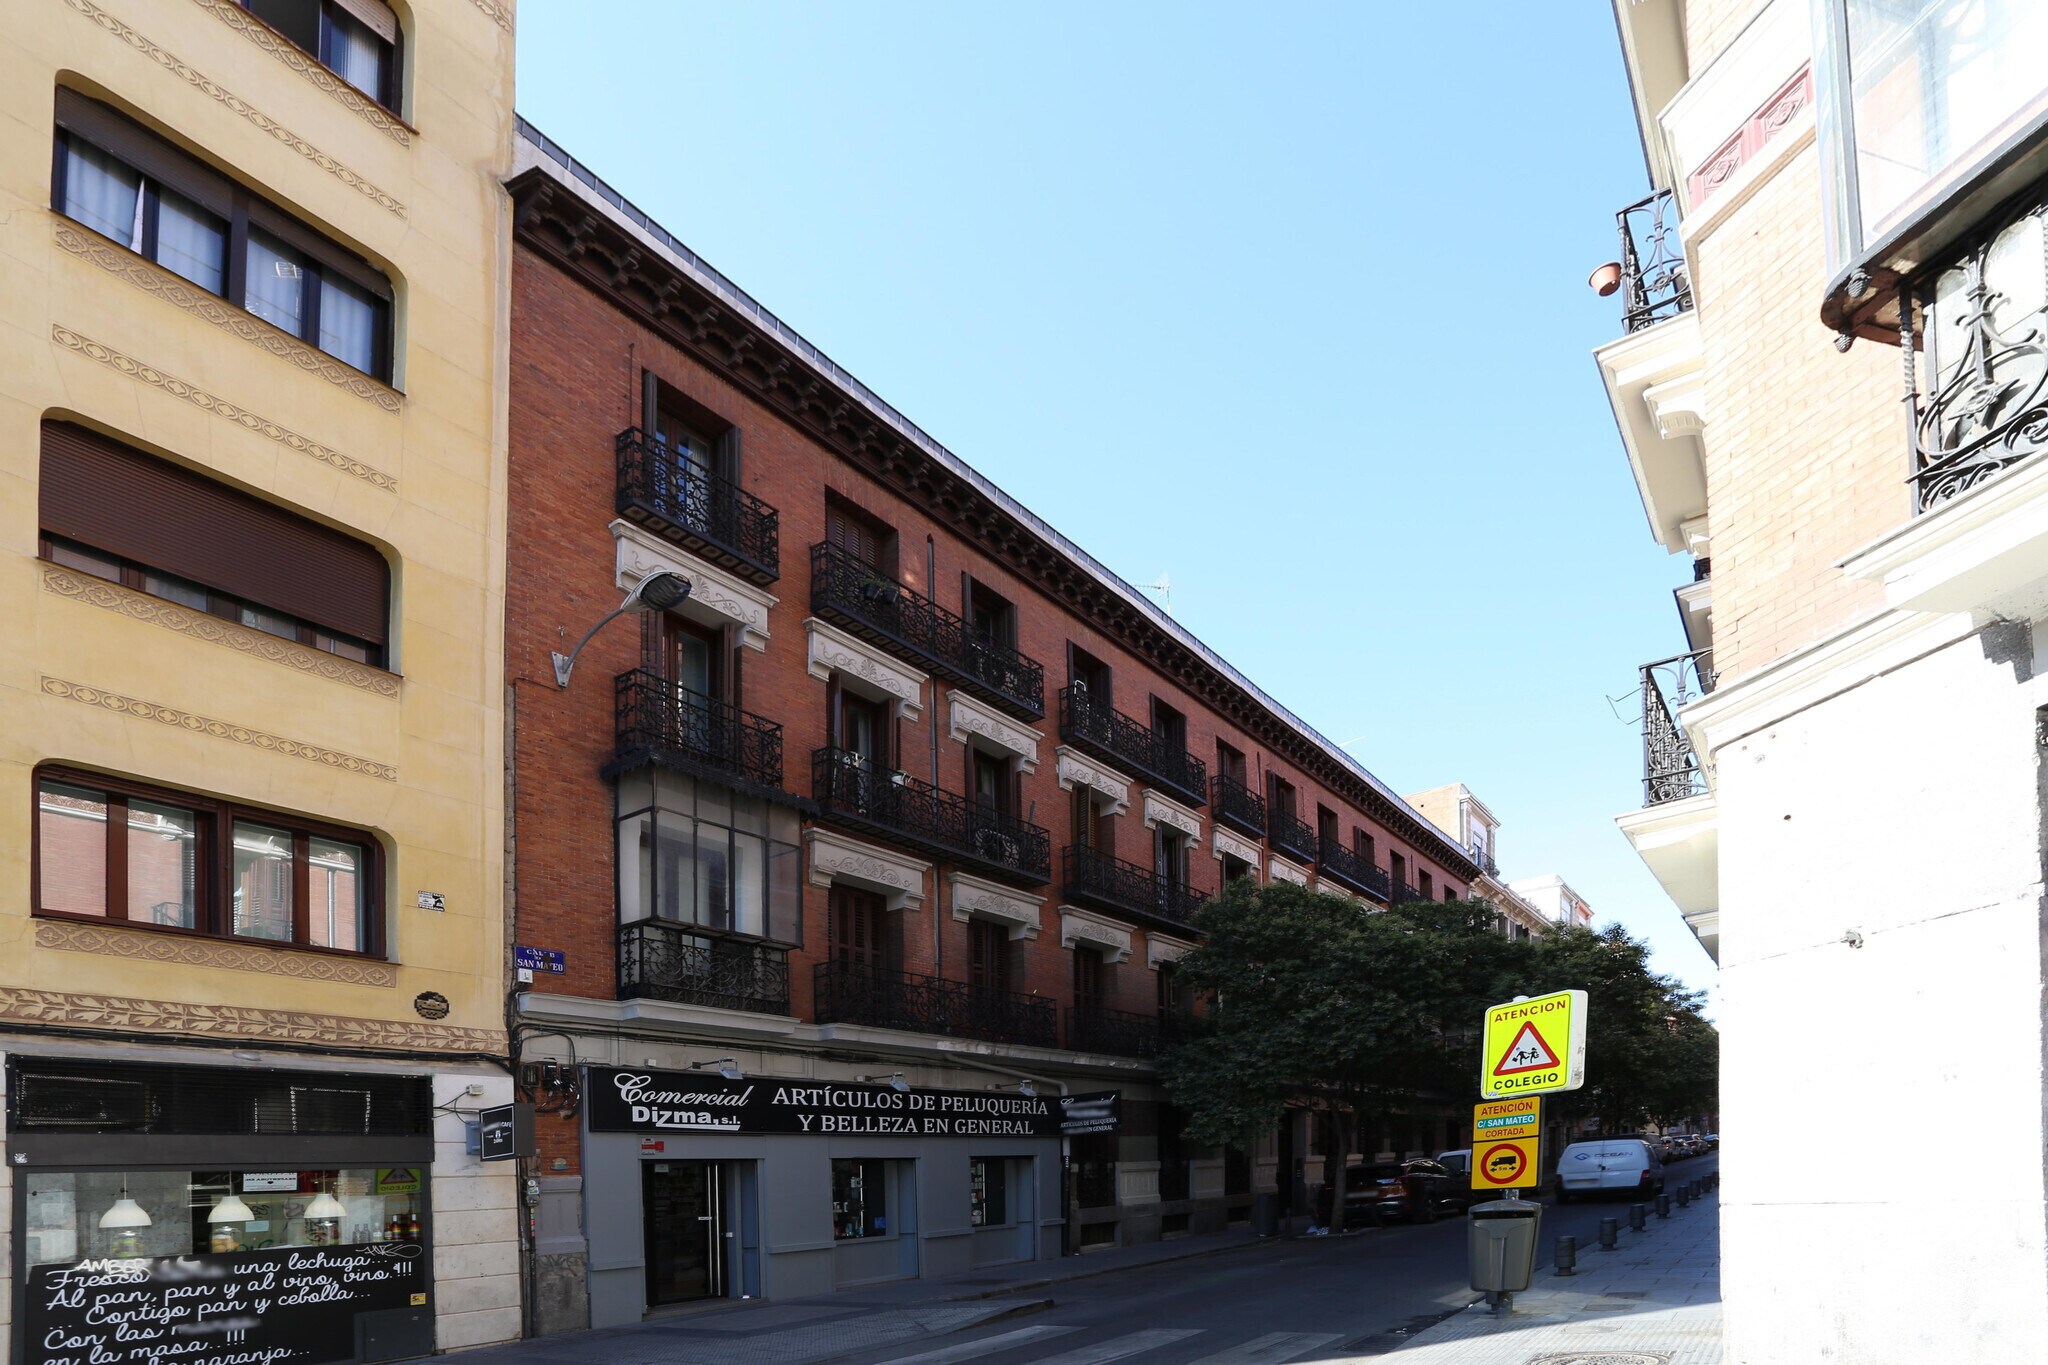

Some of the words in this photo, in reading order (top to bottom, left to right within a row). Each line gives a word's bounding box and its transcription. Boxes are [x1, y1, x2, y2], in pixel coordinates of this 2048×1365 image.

[517, 958, 535, 968] SAN
[535, 961, 563, 971] MAEO
[1494, 1000, 1566, 1022] ATENCION
[613, 1073, 755, 1107] Comercial
[1493, 1073, 1559, 1090] COLEGIO
[771, 1086, 904, 1109] ARTÍCULOS
[909, 1095, 936, 1111] DE
[940, 1096, 1049, 1116] PELUQUERÍA
[1481, 1100, 1533, 1116] ATENCIÓN
[797, 1114, 815, 1131] Y
[820, 1115, 918, 1133] BELLEZA
[923, 1118, 949, 1133] EN
[954, 1119, 1034, 1134] GENERAL
[1477, 1120, 1486, 1128] C/
[1487, 1118, 1504, 1127] SAN
[1505, 1115, 1535, 1125] MATEO
[1485, 1127, 1525, 1138] CORTADA
[233, 1261, 281, 1275] una
[46, 1288, 86, 1311] Al
[164, 1284, 216, 1307] pan
[223, 1284, 241, 1299] y
[247, 1272, 276, 1292] al
[85, 1303, 191, 1325] Contigo
[198, 1299, 247, 1321] pan
[254, 1299, 271, 1314] y
[44, 1329, 107, 1350] Con
[115, 1323, 164, 1342] las
[89, 1345, 122, 1365] la
